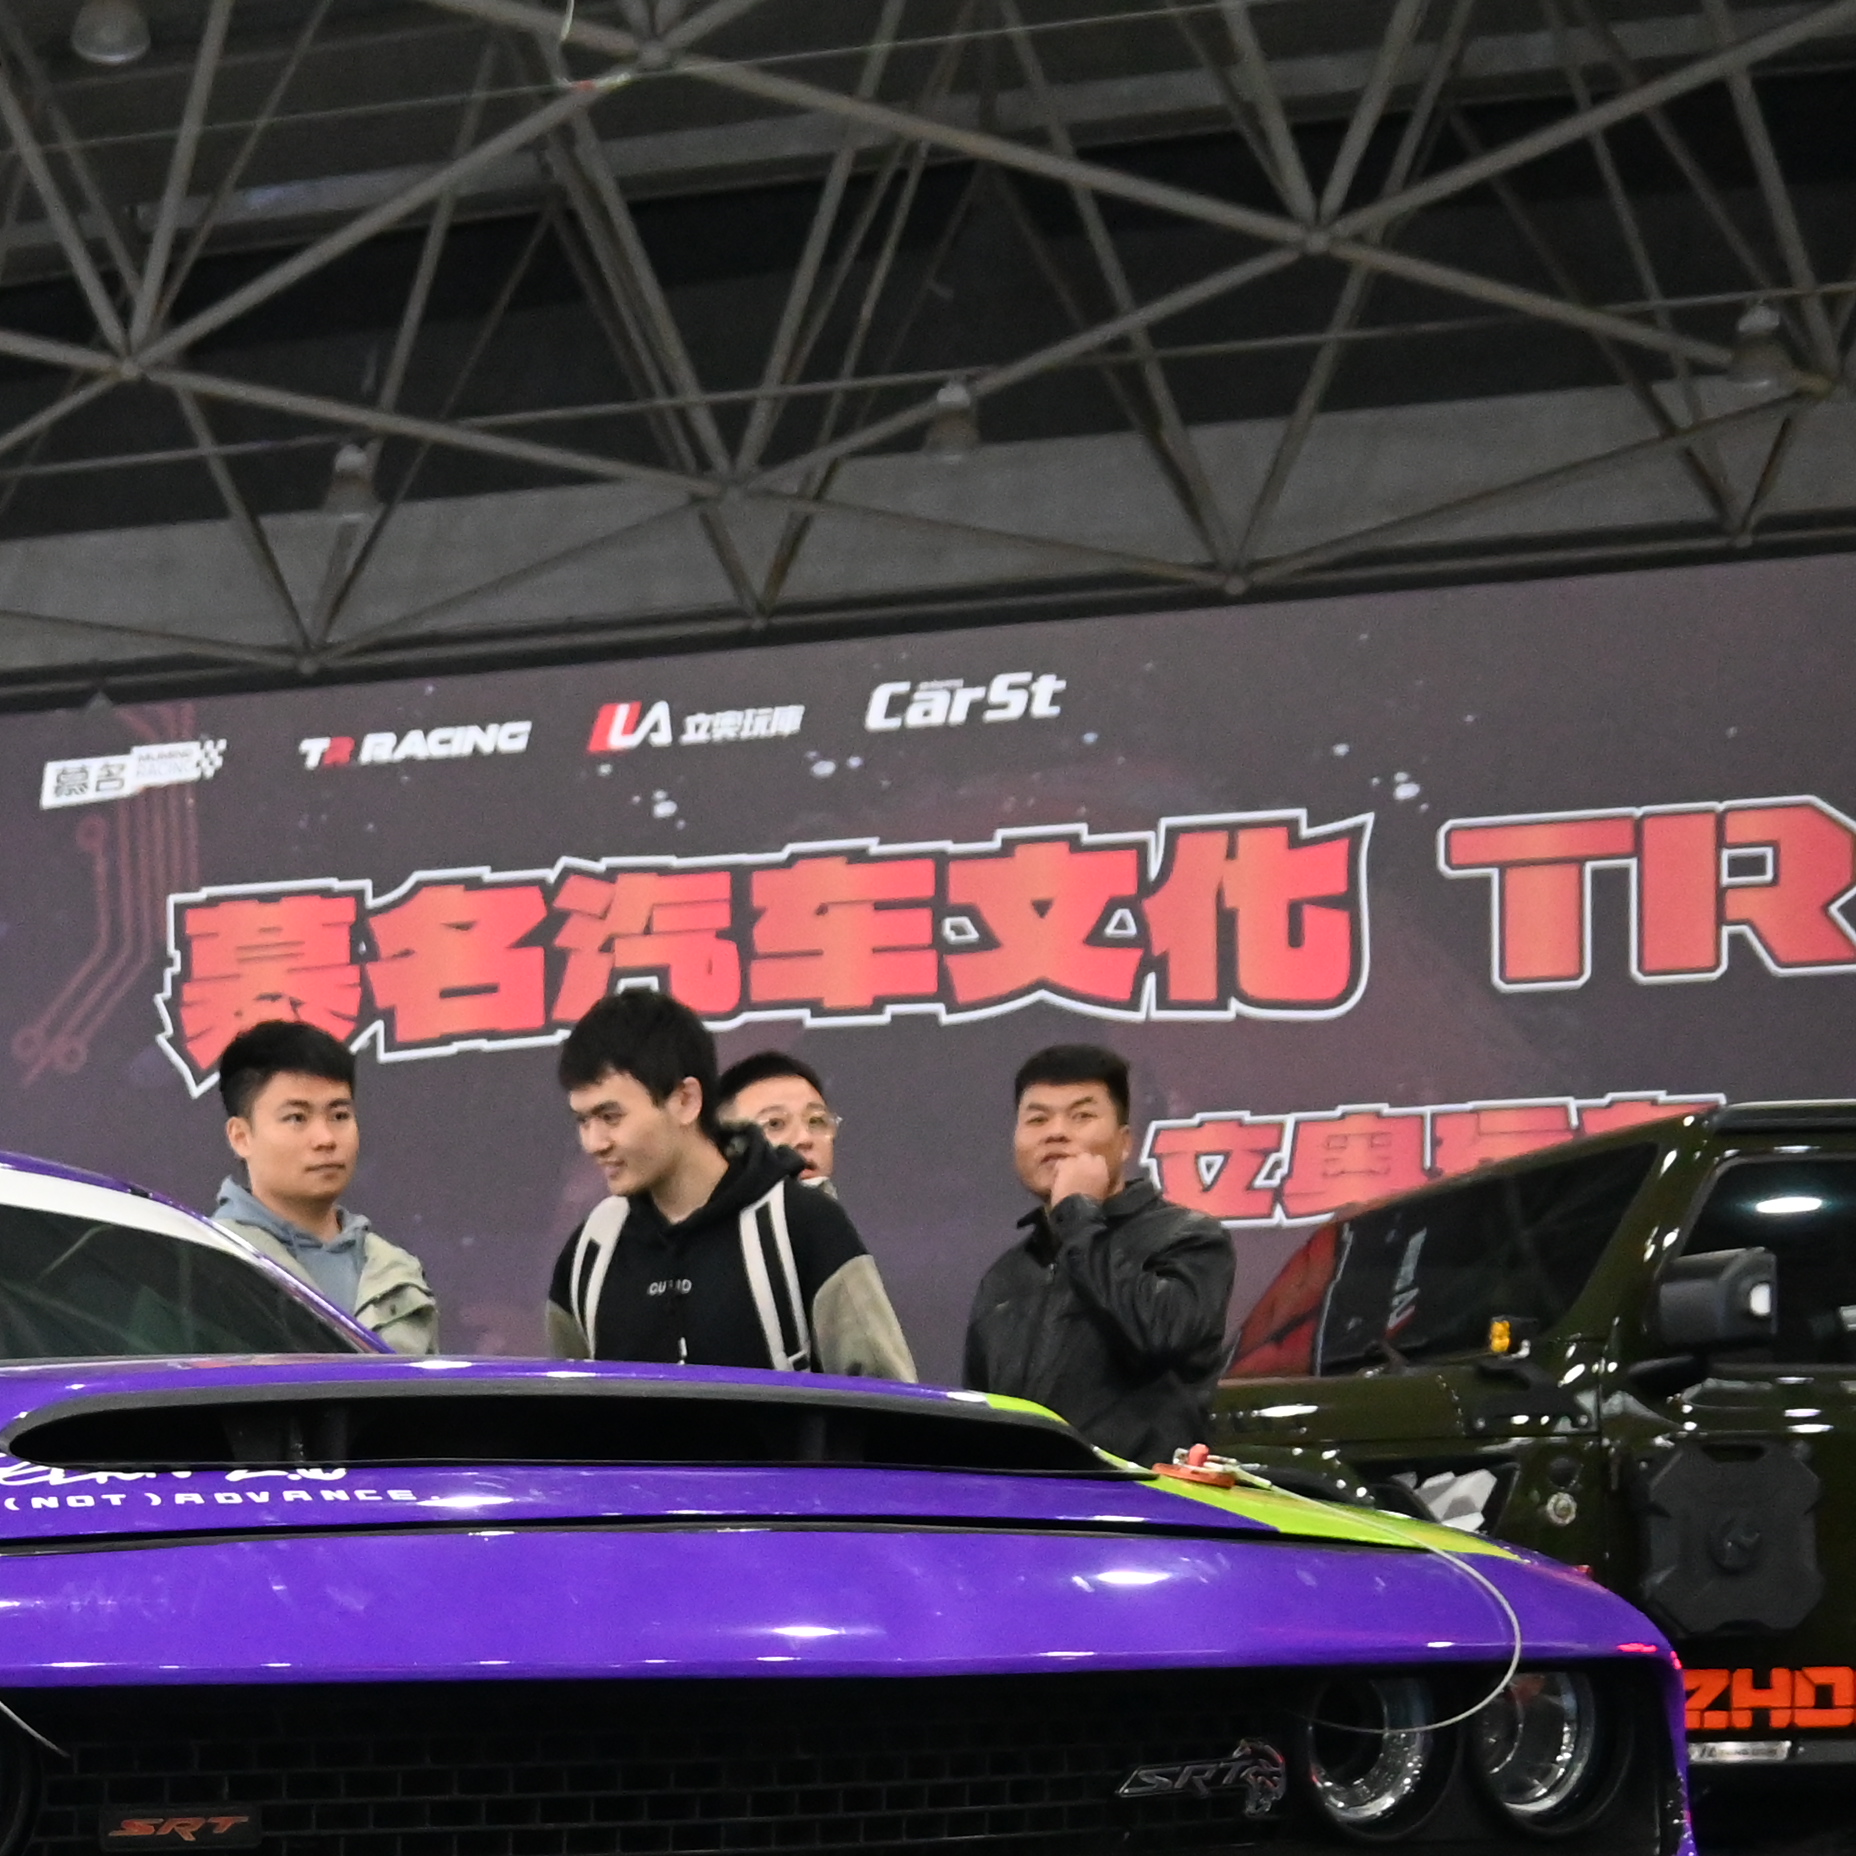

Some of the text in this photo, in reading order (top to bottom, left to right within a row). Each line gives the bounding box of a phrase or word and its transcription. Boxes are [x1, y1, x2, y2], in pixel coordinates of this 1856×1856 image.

[299, 720, 533, 769] TR RACING
[1437, 796, 1856, 992] TR
[1683, 1666, 1856, 1729] ZHO
[108, 1816, 250, 1842] SRT
